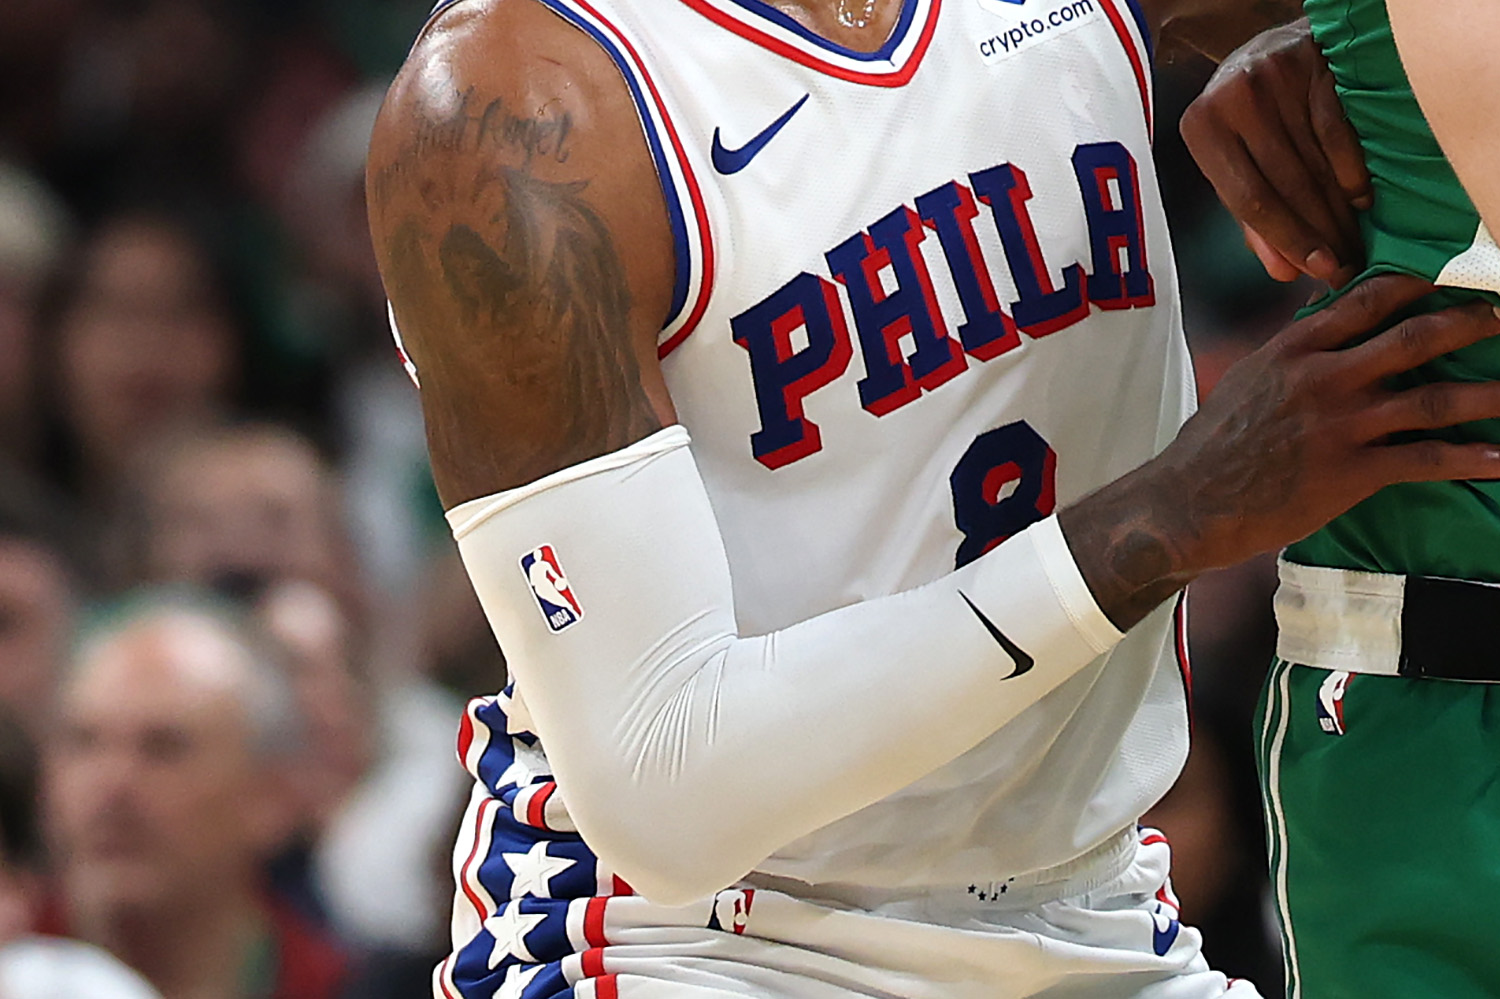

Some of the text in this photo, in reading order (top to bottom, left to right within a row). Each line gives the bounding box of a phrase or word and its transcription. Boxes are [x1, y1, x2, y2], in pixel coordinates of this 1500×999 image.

[730, 140, 1156, 471] PHILA
[949, 419, 1057, 570] 8
[549, 608, 572, 629] NBA
